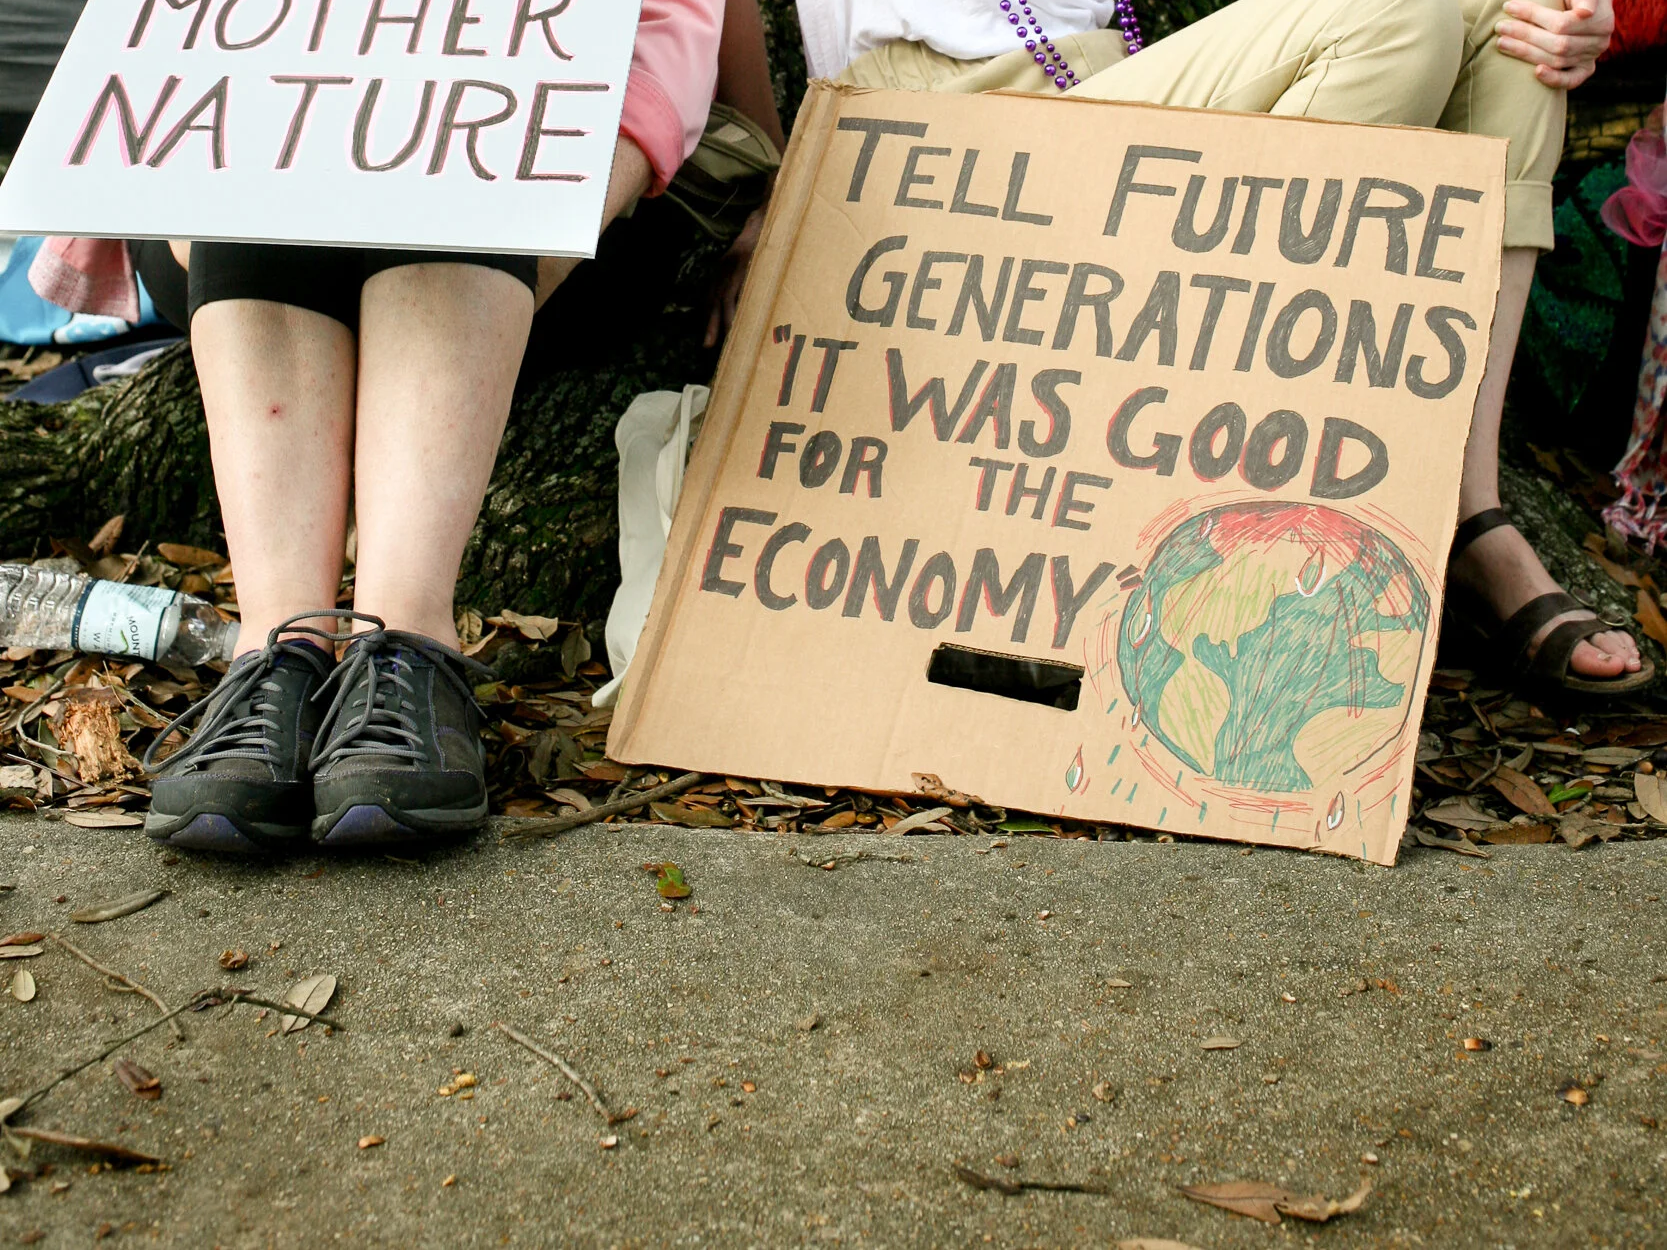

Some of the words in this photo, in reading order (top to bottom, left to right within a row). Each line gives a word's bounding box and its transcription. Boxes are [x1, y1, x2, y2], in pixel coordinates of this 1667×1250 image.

[66, 73, 611, 183] NATURE
[837, 117, 1053, 227] TELL
[1102, 144, 1485, 283] FUTURE
[845, 234, 1478, 400] GENERATIONS
[756, 420, 888, 499] FOR
[969, 456, 1114, 533] THE
[772, 322, 859, 414] "IT
[885, 347, 1083, 458] WAS
[1106, 384, 1390, 500] GOOD
[699, 506, 1143, 650] ECONOMY"
